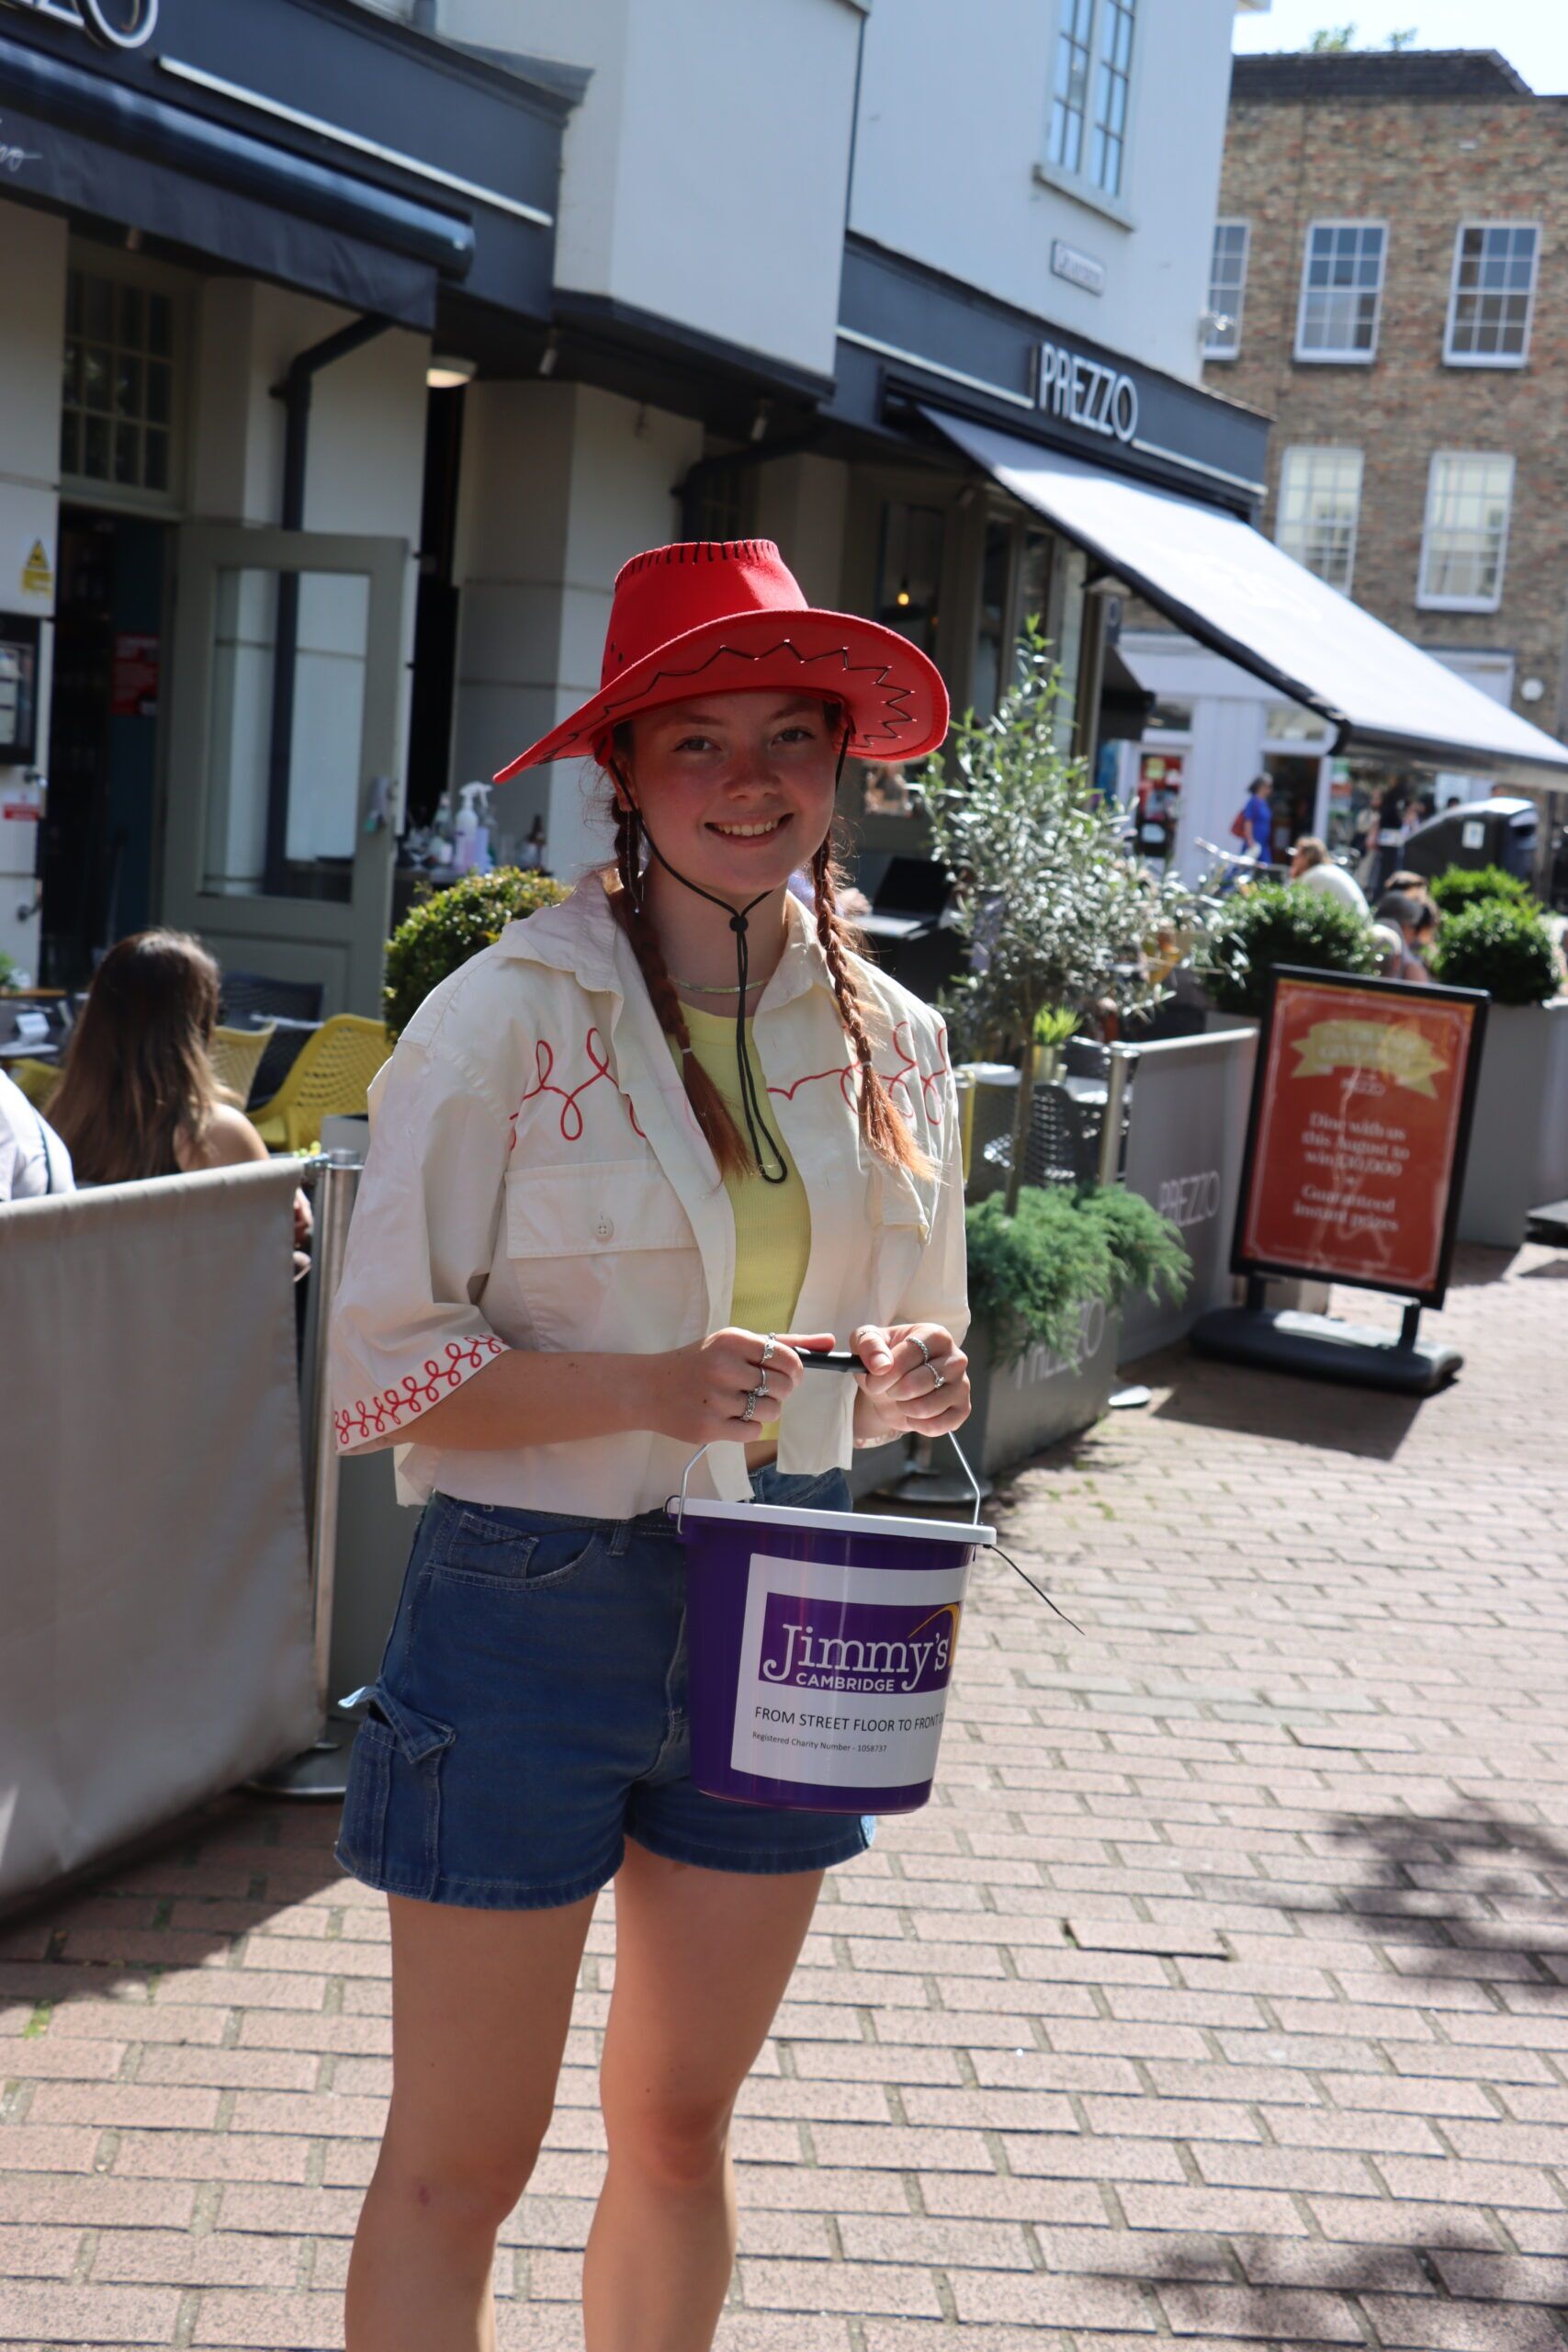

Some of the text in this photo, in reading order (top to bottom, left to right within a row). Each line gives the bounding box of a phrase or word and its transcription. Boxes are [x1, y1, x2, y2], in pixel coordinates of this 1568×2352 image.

[1039, 343, 1139, 443] PREZZO
[1309, 1112, 1407, 1141] Dine with us
[1301, 1130, 1410, 1160] this August to
[1304, 1150, 1336, 1166] win
[1301, 1183, 1396, 1213] Guaranteed
[1293, 1200, 1400, 1233] instant prizes
[763, 1623, 950, 1691] Jimmy's
[795, 1672, 895, 1692] CAMBRIDGE
[755, 1706, 795, 1724] FROM
[799, 1713, 850, 1731] STREET
[853, 1718, 895, 1733] FLOOR
[898, 1718, 912, 1732] TO
[914, 1713, 939, 1730] FRONT
[752, 1731, 790, 1745] Registered
[791, 1738, 818, 1750] Charity
[820, 1742, 851, 1751] Number
[858, 1744, 887, 1753] 1058737
